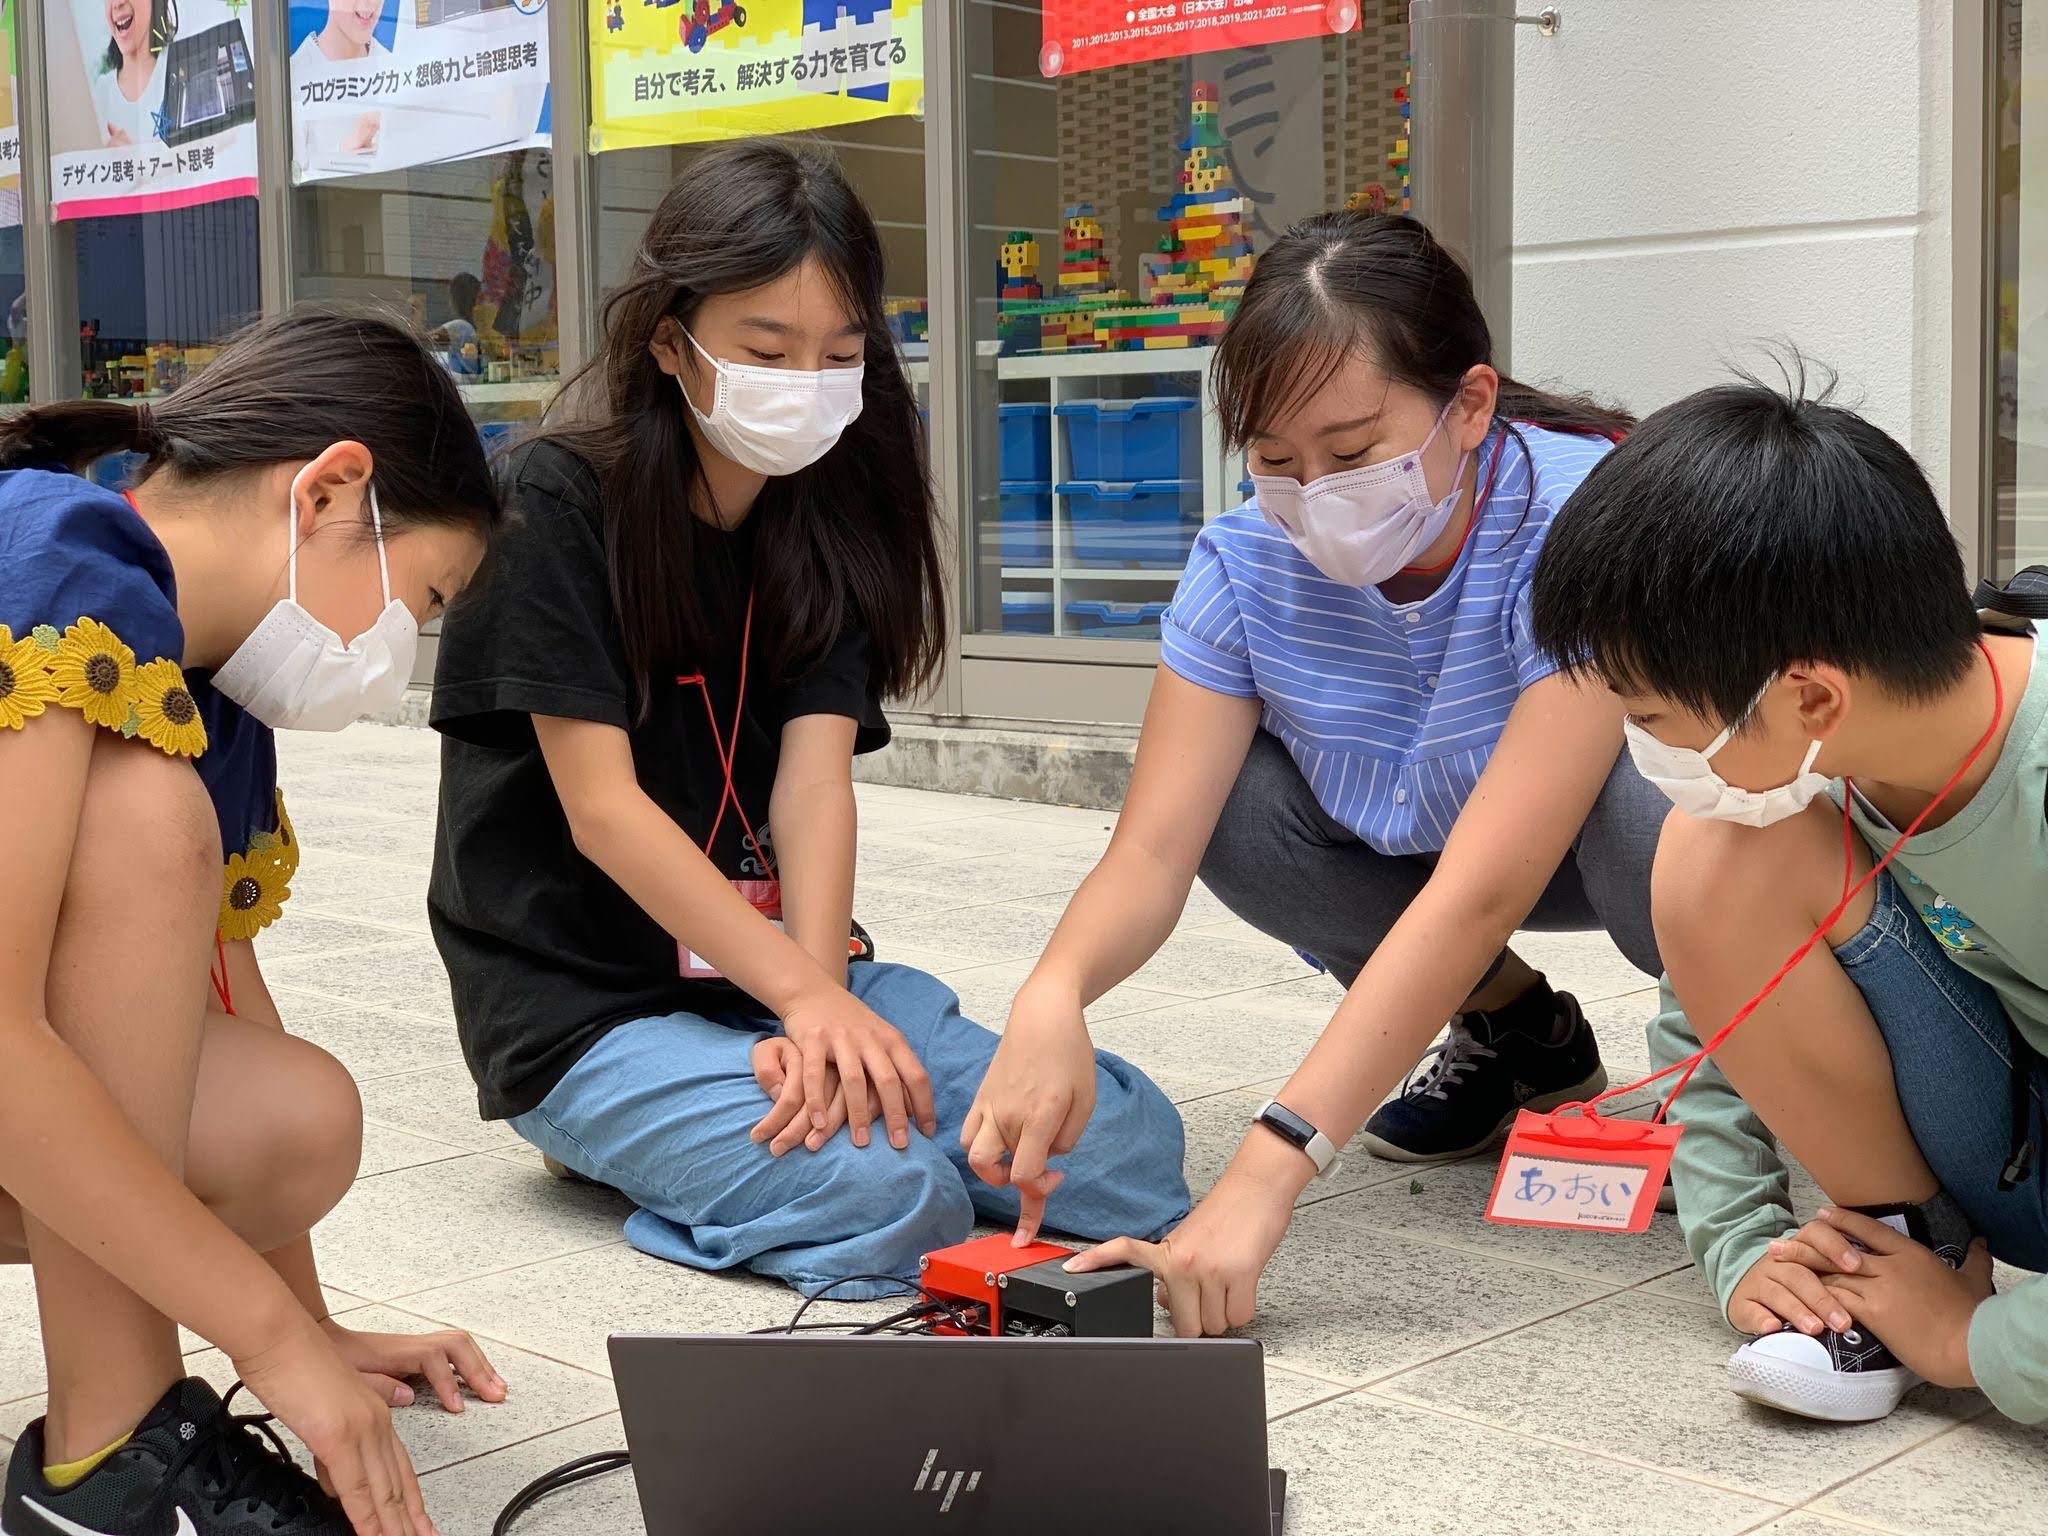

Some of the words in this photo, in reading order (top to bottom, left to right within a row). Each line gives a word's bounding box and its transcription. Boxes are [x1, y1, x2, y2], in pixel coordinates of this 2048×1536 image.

[634, 37, 907, 101] 自分で考え、解決する力を育てる
[1514, 1166, 1632, 1206] あおい
[913, 1448, 982, 1512] hp
